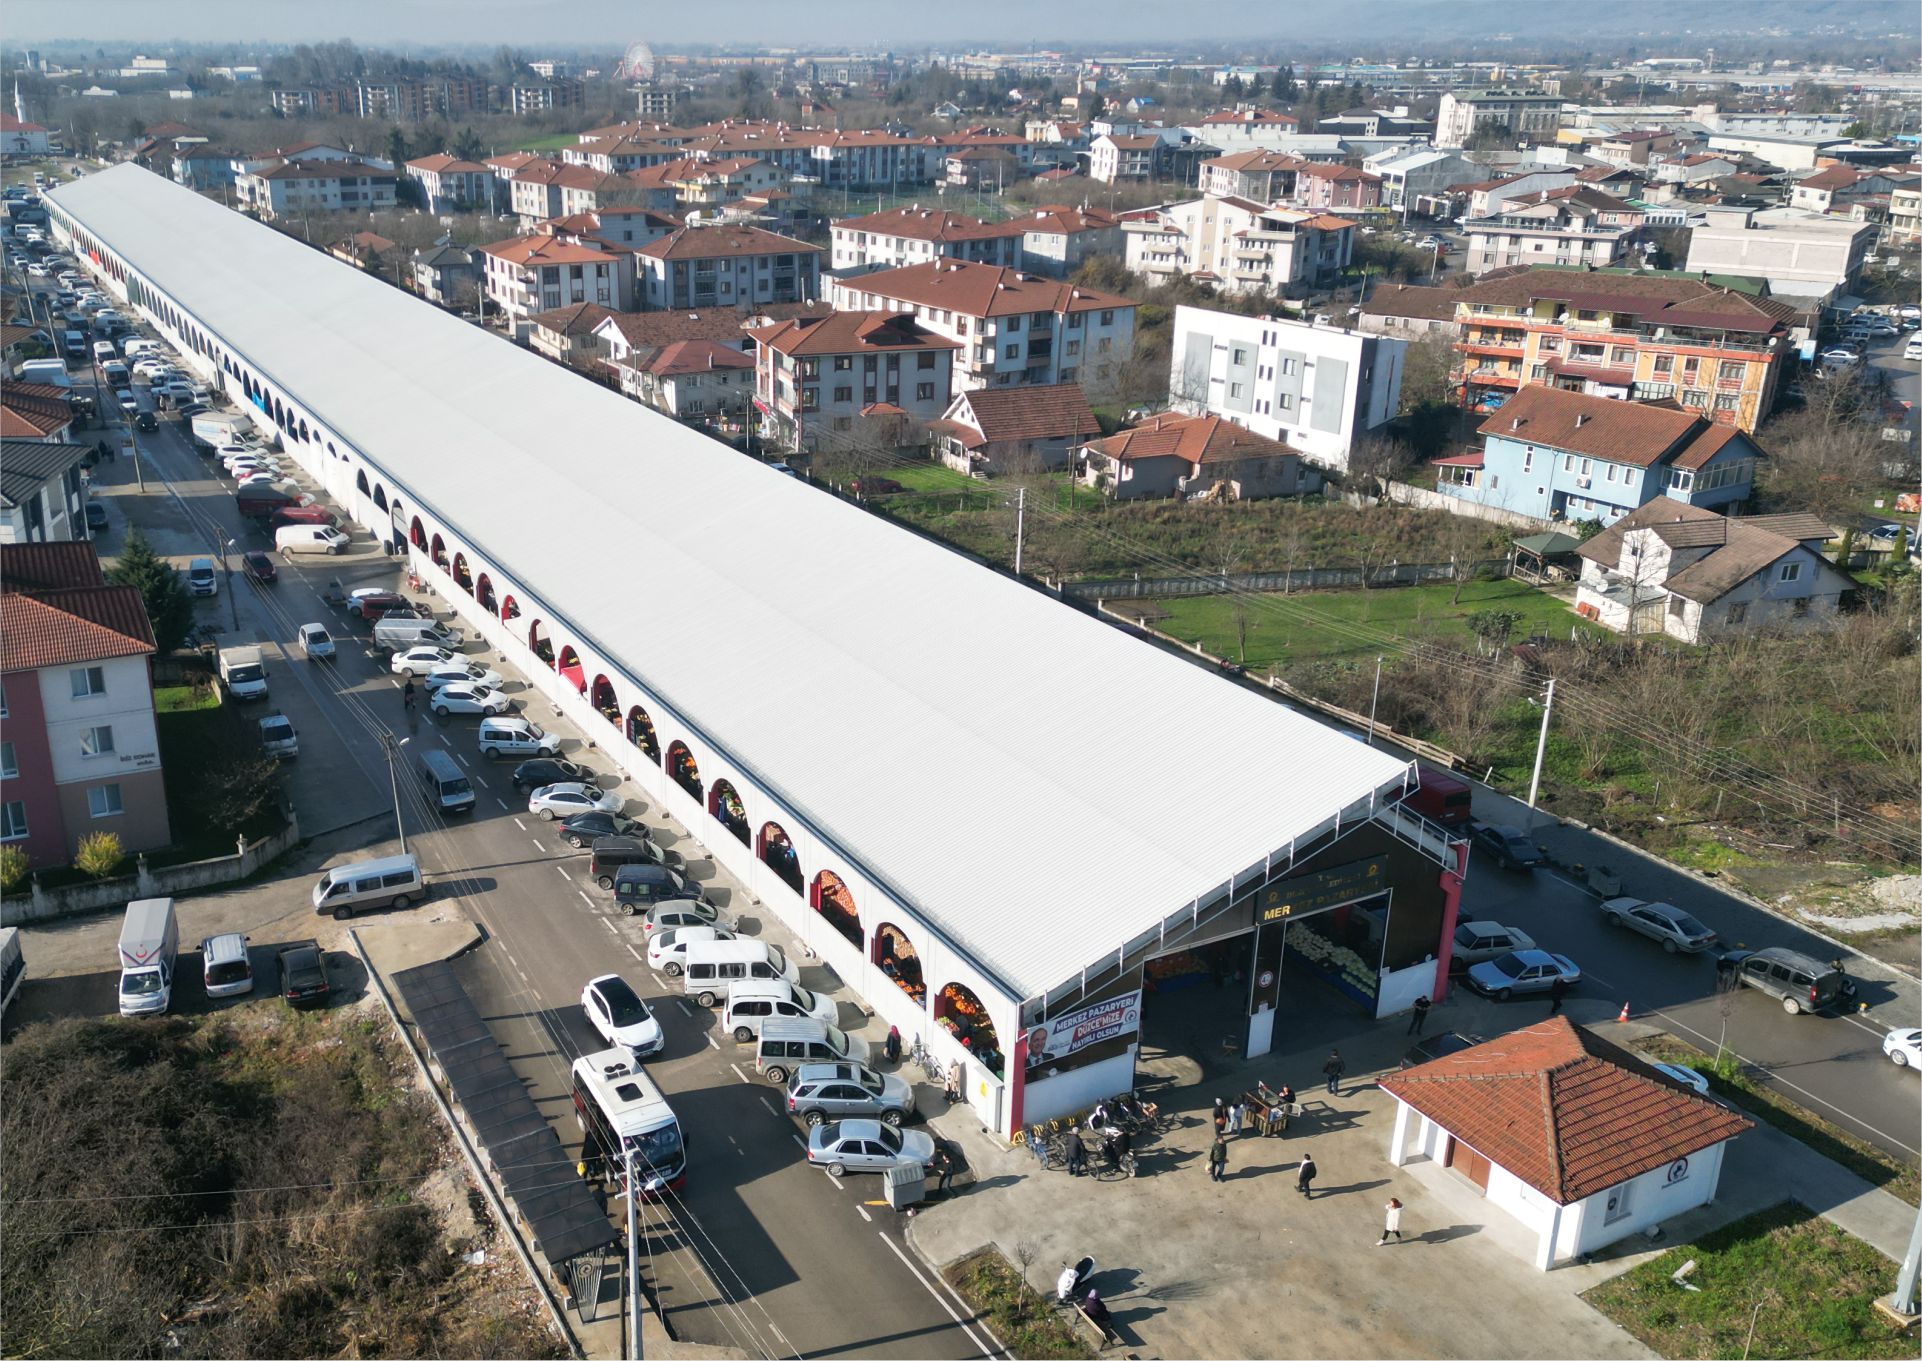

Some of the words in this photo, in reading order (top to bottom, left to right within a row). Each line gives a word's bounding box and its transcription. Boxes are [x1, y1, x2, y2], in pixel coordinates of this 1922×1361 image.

[1056, 1012, 1088, 1032] MERKEZ
[1088, 996, 1134, 1018] PAZARYERİ
[1096, 1026, 1120, 1040] OLSUN
